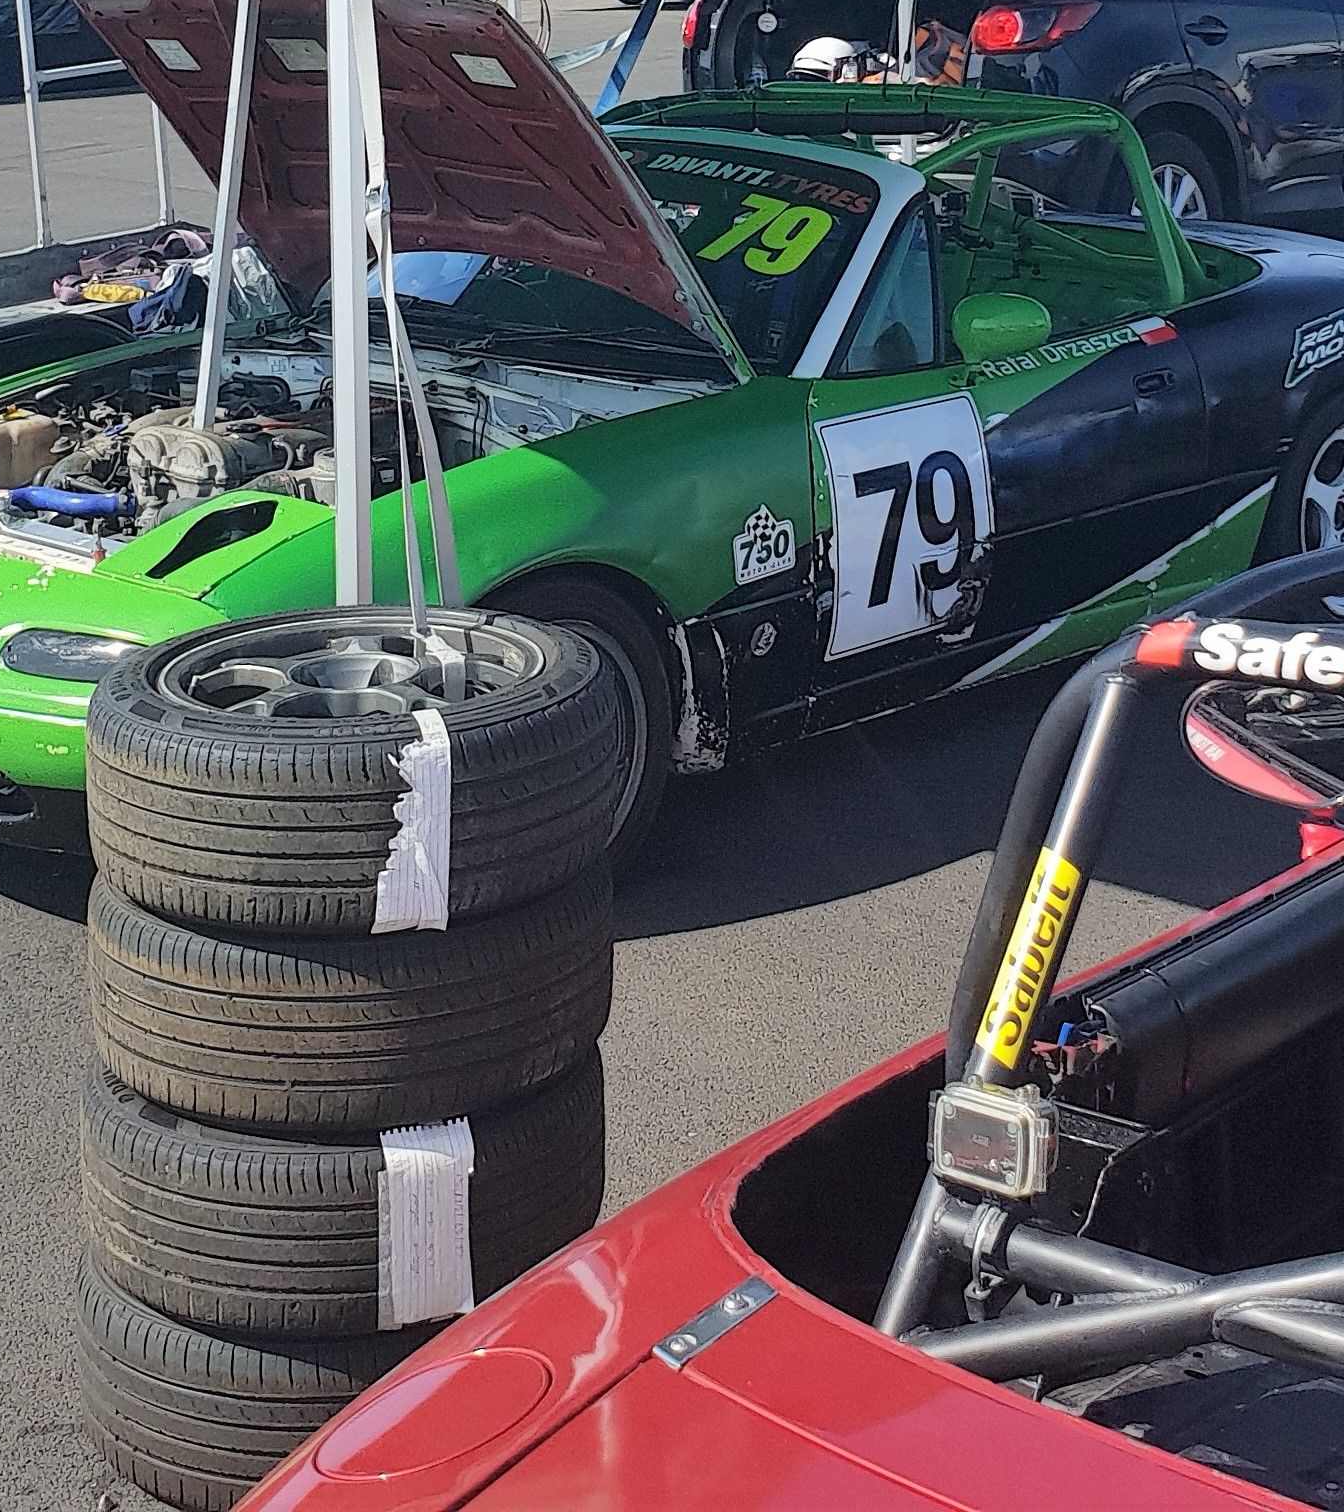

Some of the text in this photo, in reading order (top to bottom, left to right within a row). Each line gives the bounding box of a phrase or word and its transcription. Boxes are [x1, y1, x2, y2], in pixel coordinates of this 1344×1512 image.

[696, 193, 834, 276] 79
[739, 529, 790, 571] 750
[852, 449, 976, 609] 79
